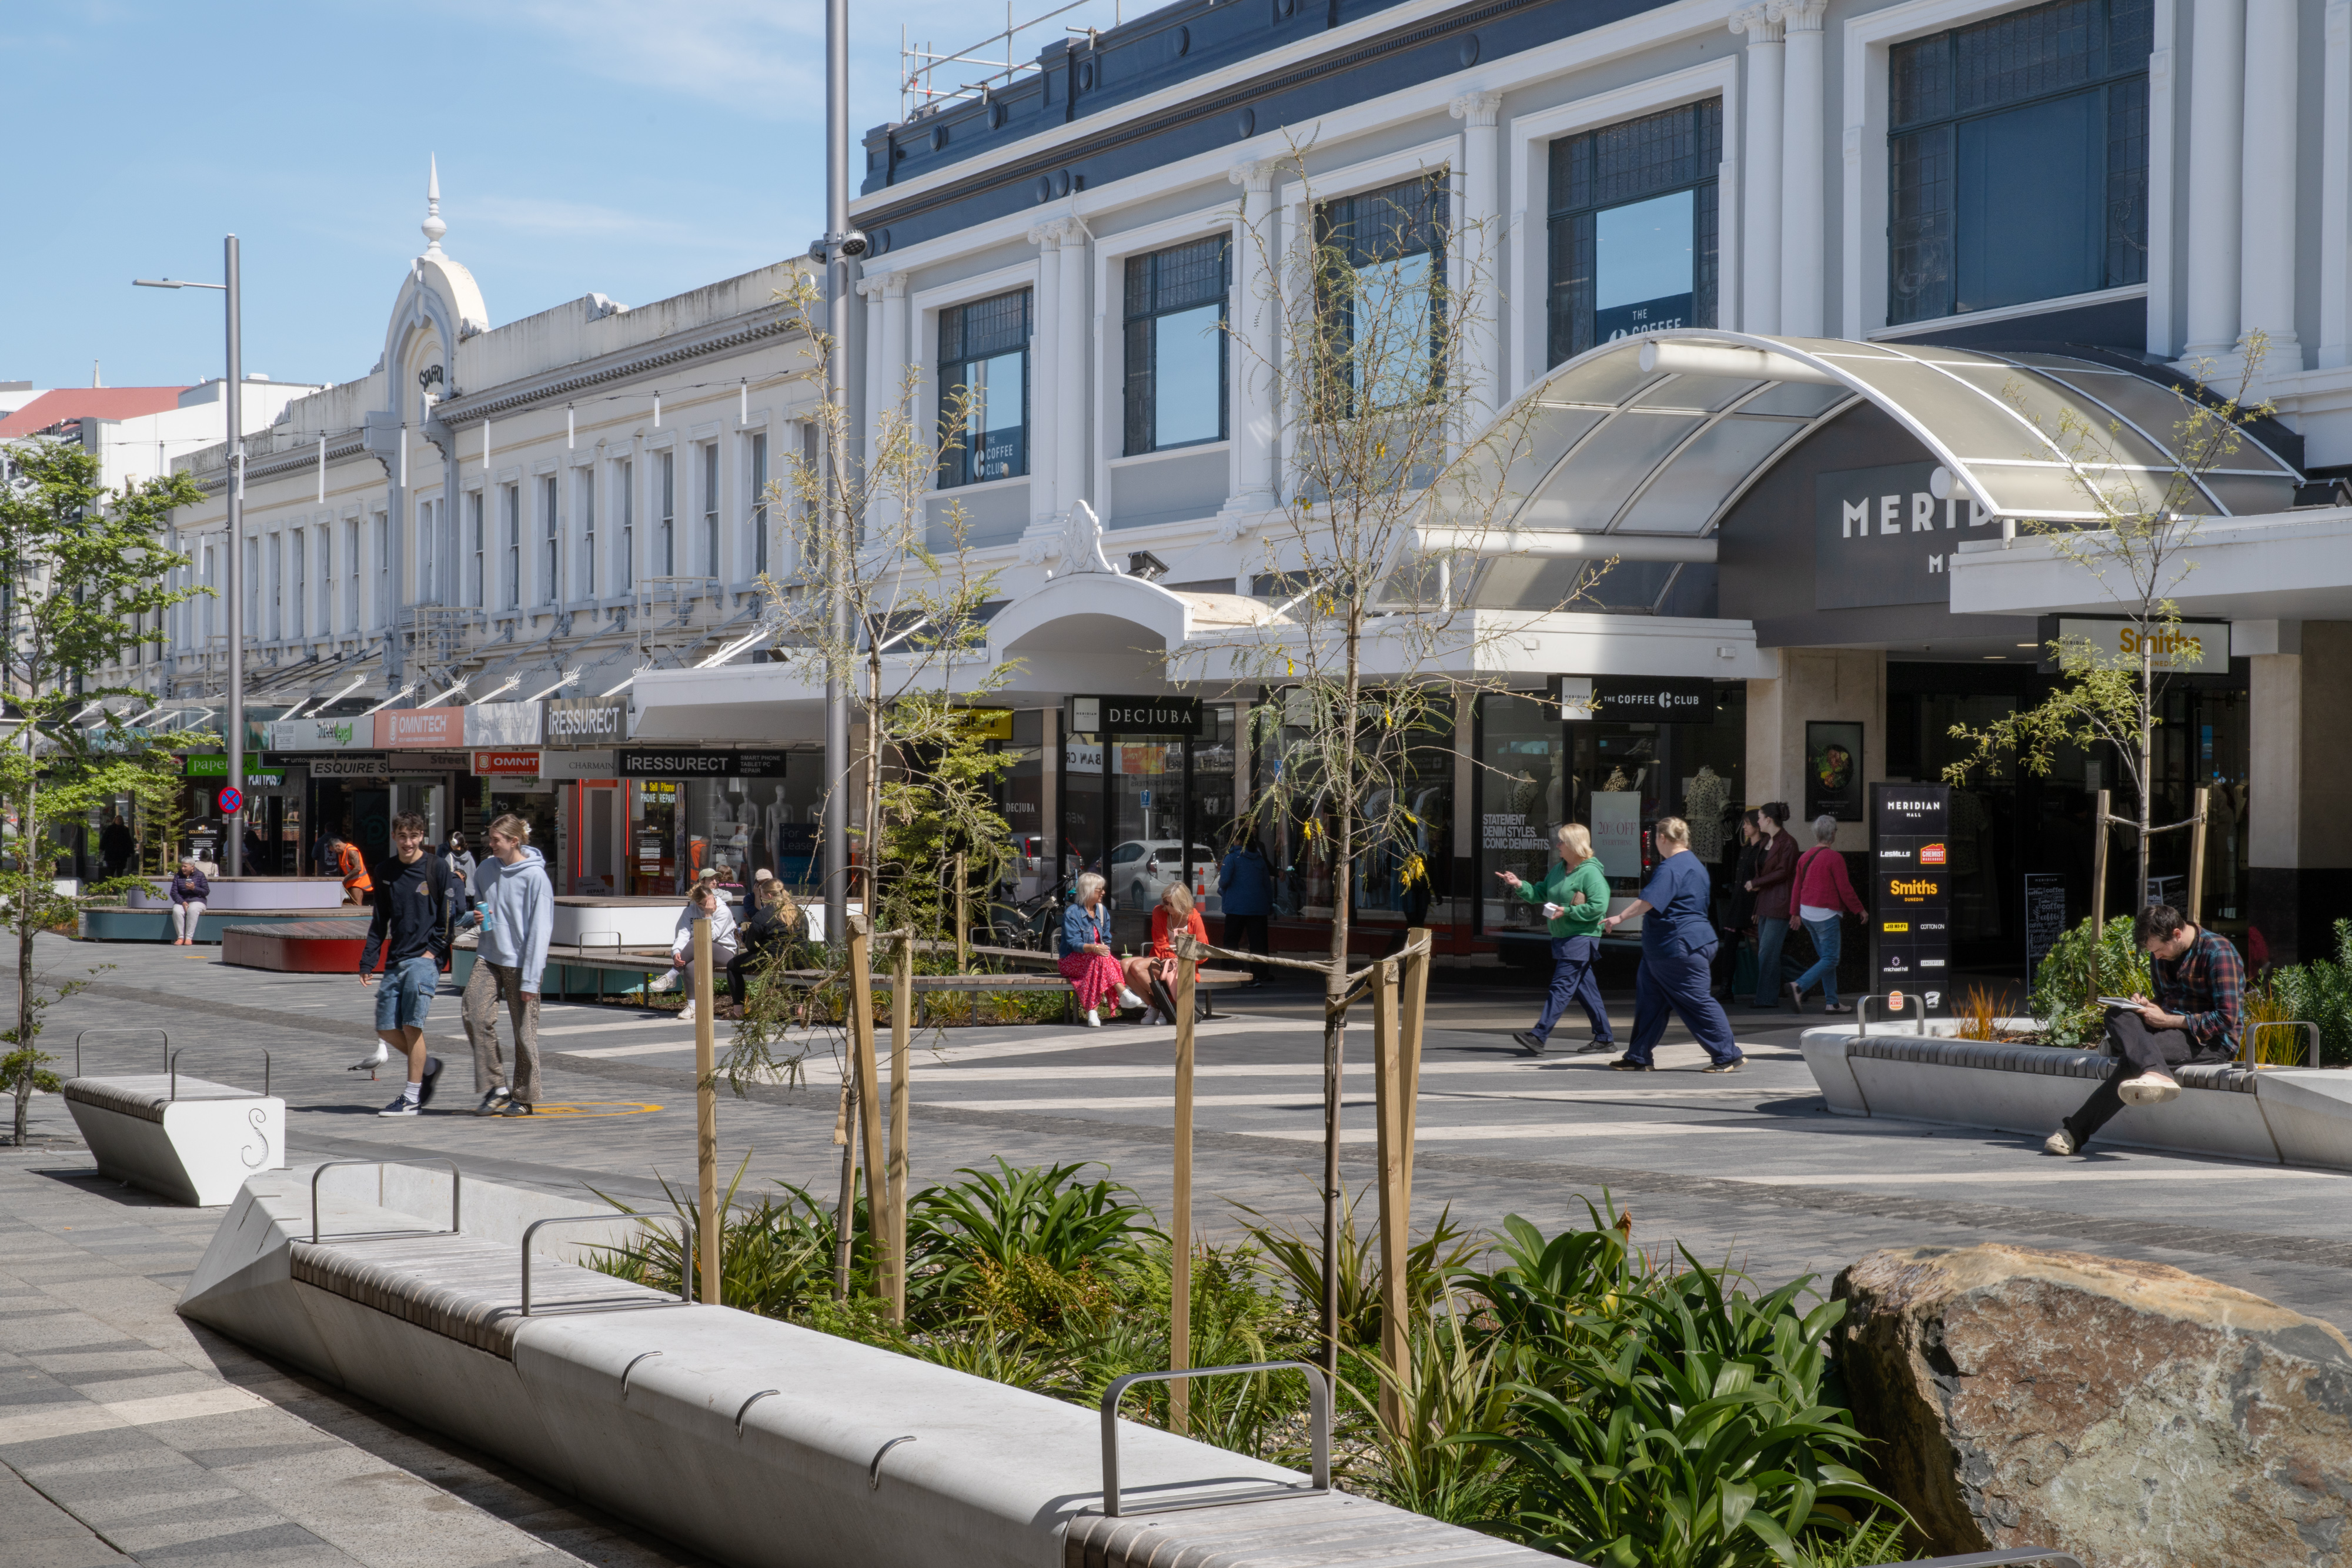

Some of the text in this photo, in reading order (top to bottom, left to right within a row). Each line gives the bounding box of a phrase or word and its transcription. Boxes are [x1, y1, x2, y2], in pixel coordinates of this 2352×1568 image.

[1632, 309, 1647, 320] THE
[987, 444, 1013, 460] COFFEE
[987, 462, 1004, 475] CLUB
[2119, 627, 2201, 654] Smiths
[1618, 695, 1655, 704] COFFEE
[1675, 696, 1699, 704] CLUB
[548, 707, 620, 735] iRESSURECT
[1110, 708, 1192, 724] DECJUBA
[399, 715, 446, 733] OMNITECH
[430, 755, 466, 764] Street
[493, 757, 539, 765] OMNIT
[627, 754, 729, 770] iRESSURECT
[315, 763, 375, 774] ESQUIRE
[248, 775, 276, 785] PLATYPUS
[649, 782, 658, 791] Sell
[661, 782, 675, 792] Phone
[640, 793, 676, 803] PHONE REPAIR
[1006, 803, 1035, 813] DECJUBA
[1887, 801, 1940, 810] MERIDIAN
[1483, 814, 1526, 825] STATEMENT
[783, 828, 799, 838] For
[1483, 826, 1537, 838] DENIM STYLES.
[1598, 821, 1636, 835] 20% OFF
[783, 841, 813, 850] Lease
[1483, 838, 1551, 850] ICONIC DENIM FITS.
[1890, 879, 1937, 895] Smiths
